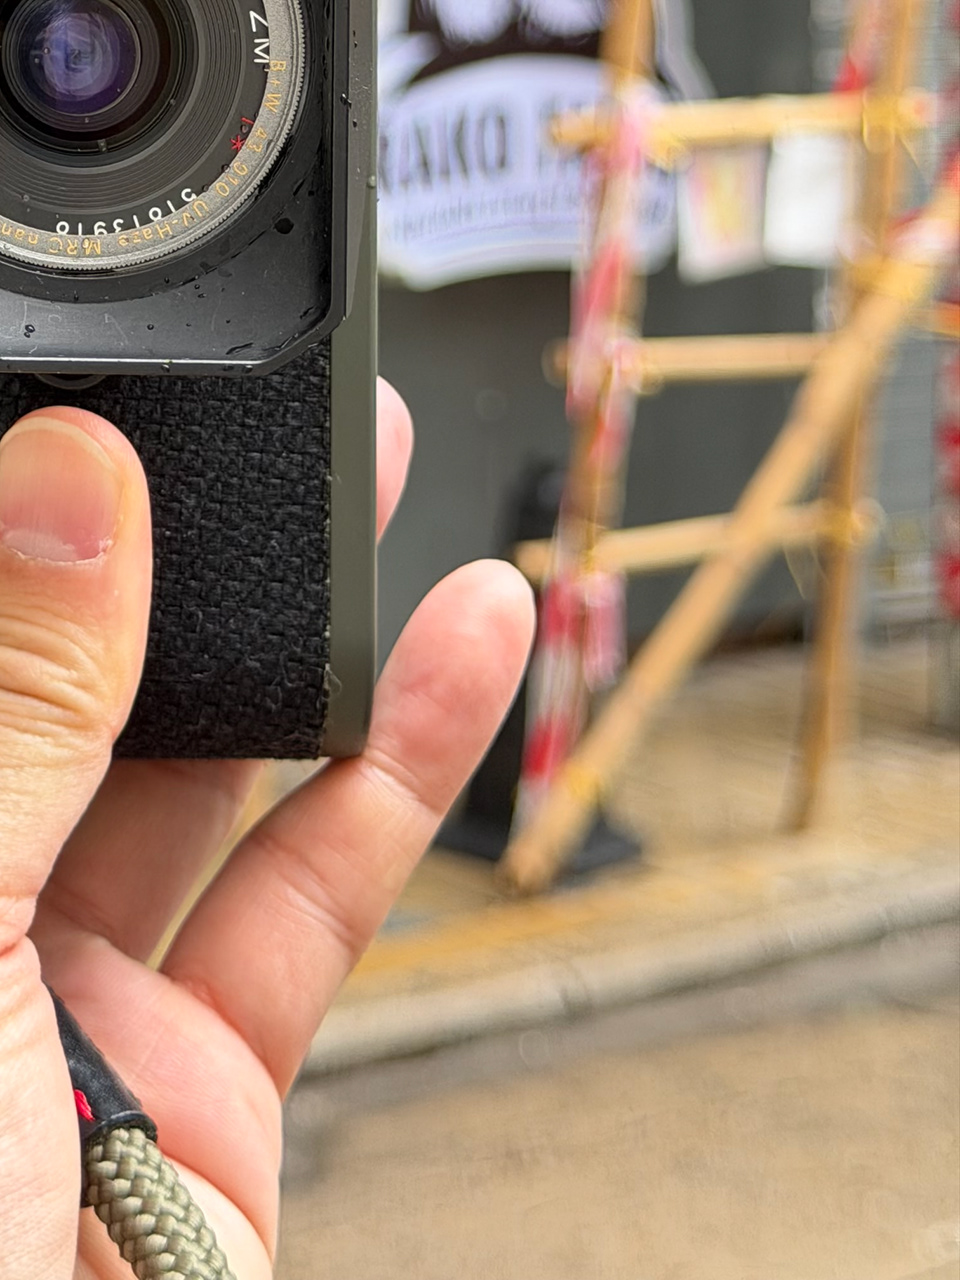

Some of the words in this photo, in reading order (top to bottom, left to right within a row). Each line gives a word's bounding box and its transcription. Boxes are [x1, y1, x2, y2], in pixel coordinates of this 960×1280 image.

[248, 10, 271, 63] ZM
[263, 60, 287, 114] B+W
[246, 127, 267, 153] 43
[215, 161, 249, 197] 010
[118, 200, 209, 247] UV-Haze
[48, 236, 102, 255] MRC
